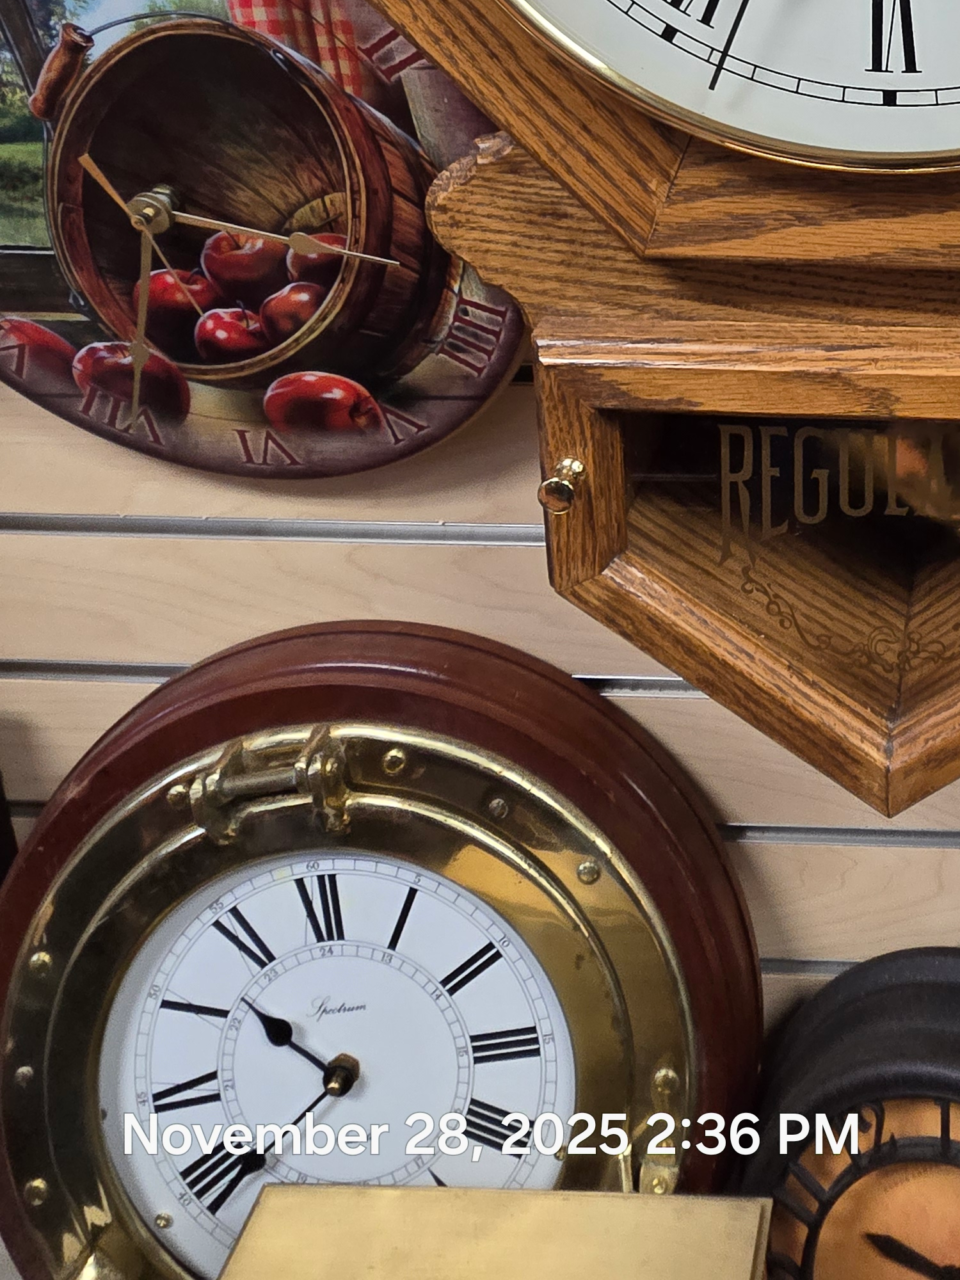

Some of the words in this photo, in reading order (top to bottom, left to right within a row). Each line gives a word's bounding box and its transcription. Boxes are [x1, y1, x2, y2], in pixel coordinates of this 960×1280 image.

[435, 296, 510, 378] IIII
[377, 400, 431, 446] V
[233, 428, 304, 467] VI
[306, 860, 320, 870] 60
[412, 874, 422, 885] 5
[209, 900, 225, 915] 55
[292, 873, 345, 947] XII
[387, 886, 419, 951] I
[211, 905, 277, 978] XI
[319, 945, 335, 957] 24
[498, 934, 511, 949] 10
[263, 969, 279, 983] 23
[438, 940, 504, 997] II
[158, 988, 231, 1031] X
[229, 1016, 243, 1032] 22
[305, 995, 367, 1022] Spectrum
[469, 1025, 542, 1065] III
[151, 1069, 222, 1114] IX
